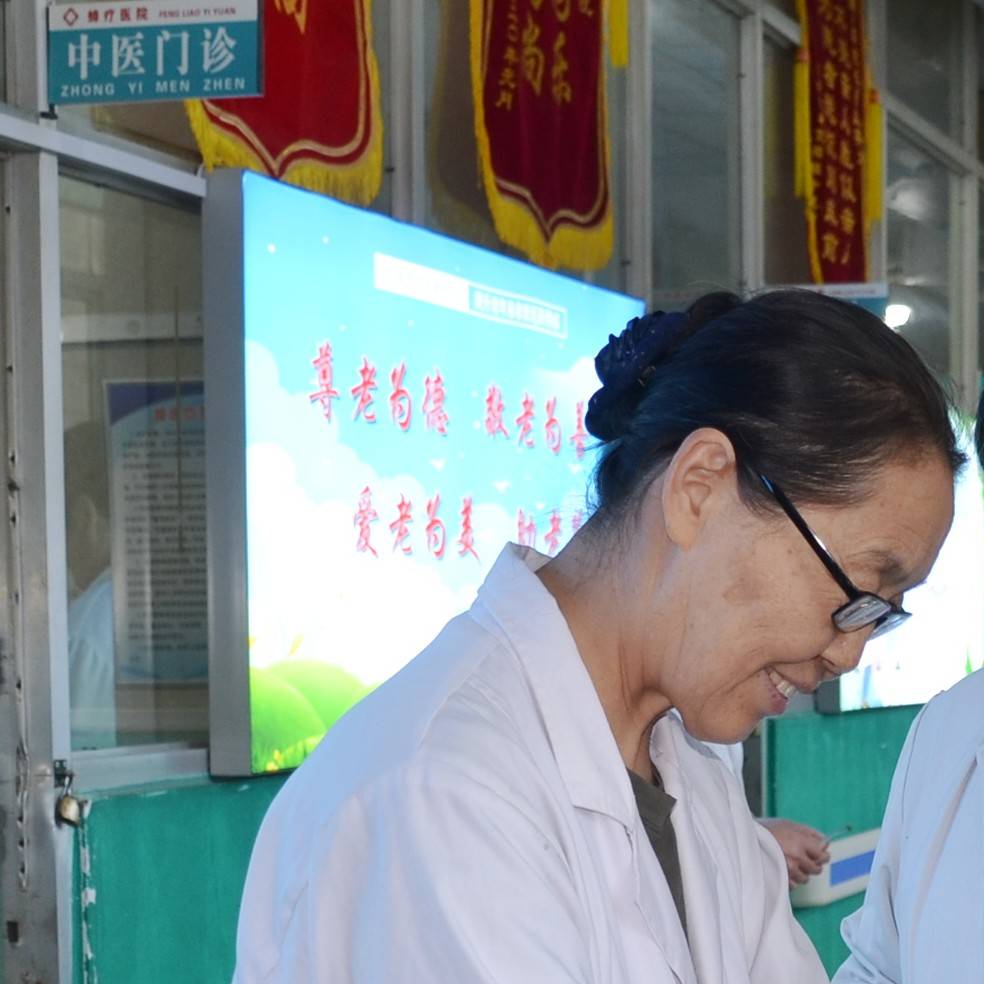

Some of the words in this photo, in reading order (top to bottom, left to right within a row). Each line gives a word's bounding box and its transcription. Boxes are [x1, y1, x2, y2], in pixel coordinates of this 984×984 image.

[182, 9, 201, 18] LIAO
[203, 8, 212, 17] YI
[213, 7, 237, 17] YUAN
[67, 26, 237, 80] 中医门诊
[60, 83, 115, 98] ZHONG
[128, 82, 143, 95] YI
[156, 80, 190, 93] MEN
[203, 78, 246, 92] ZHEN
[309, 342, 449, 437] 尊老为德
[354, 485, 482, 563] 爱老为美
